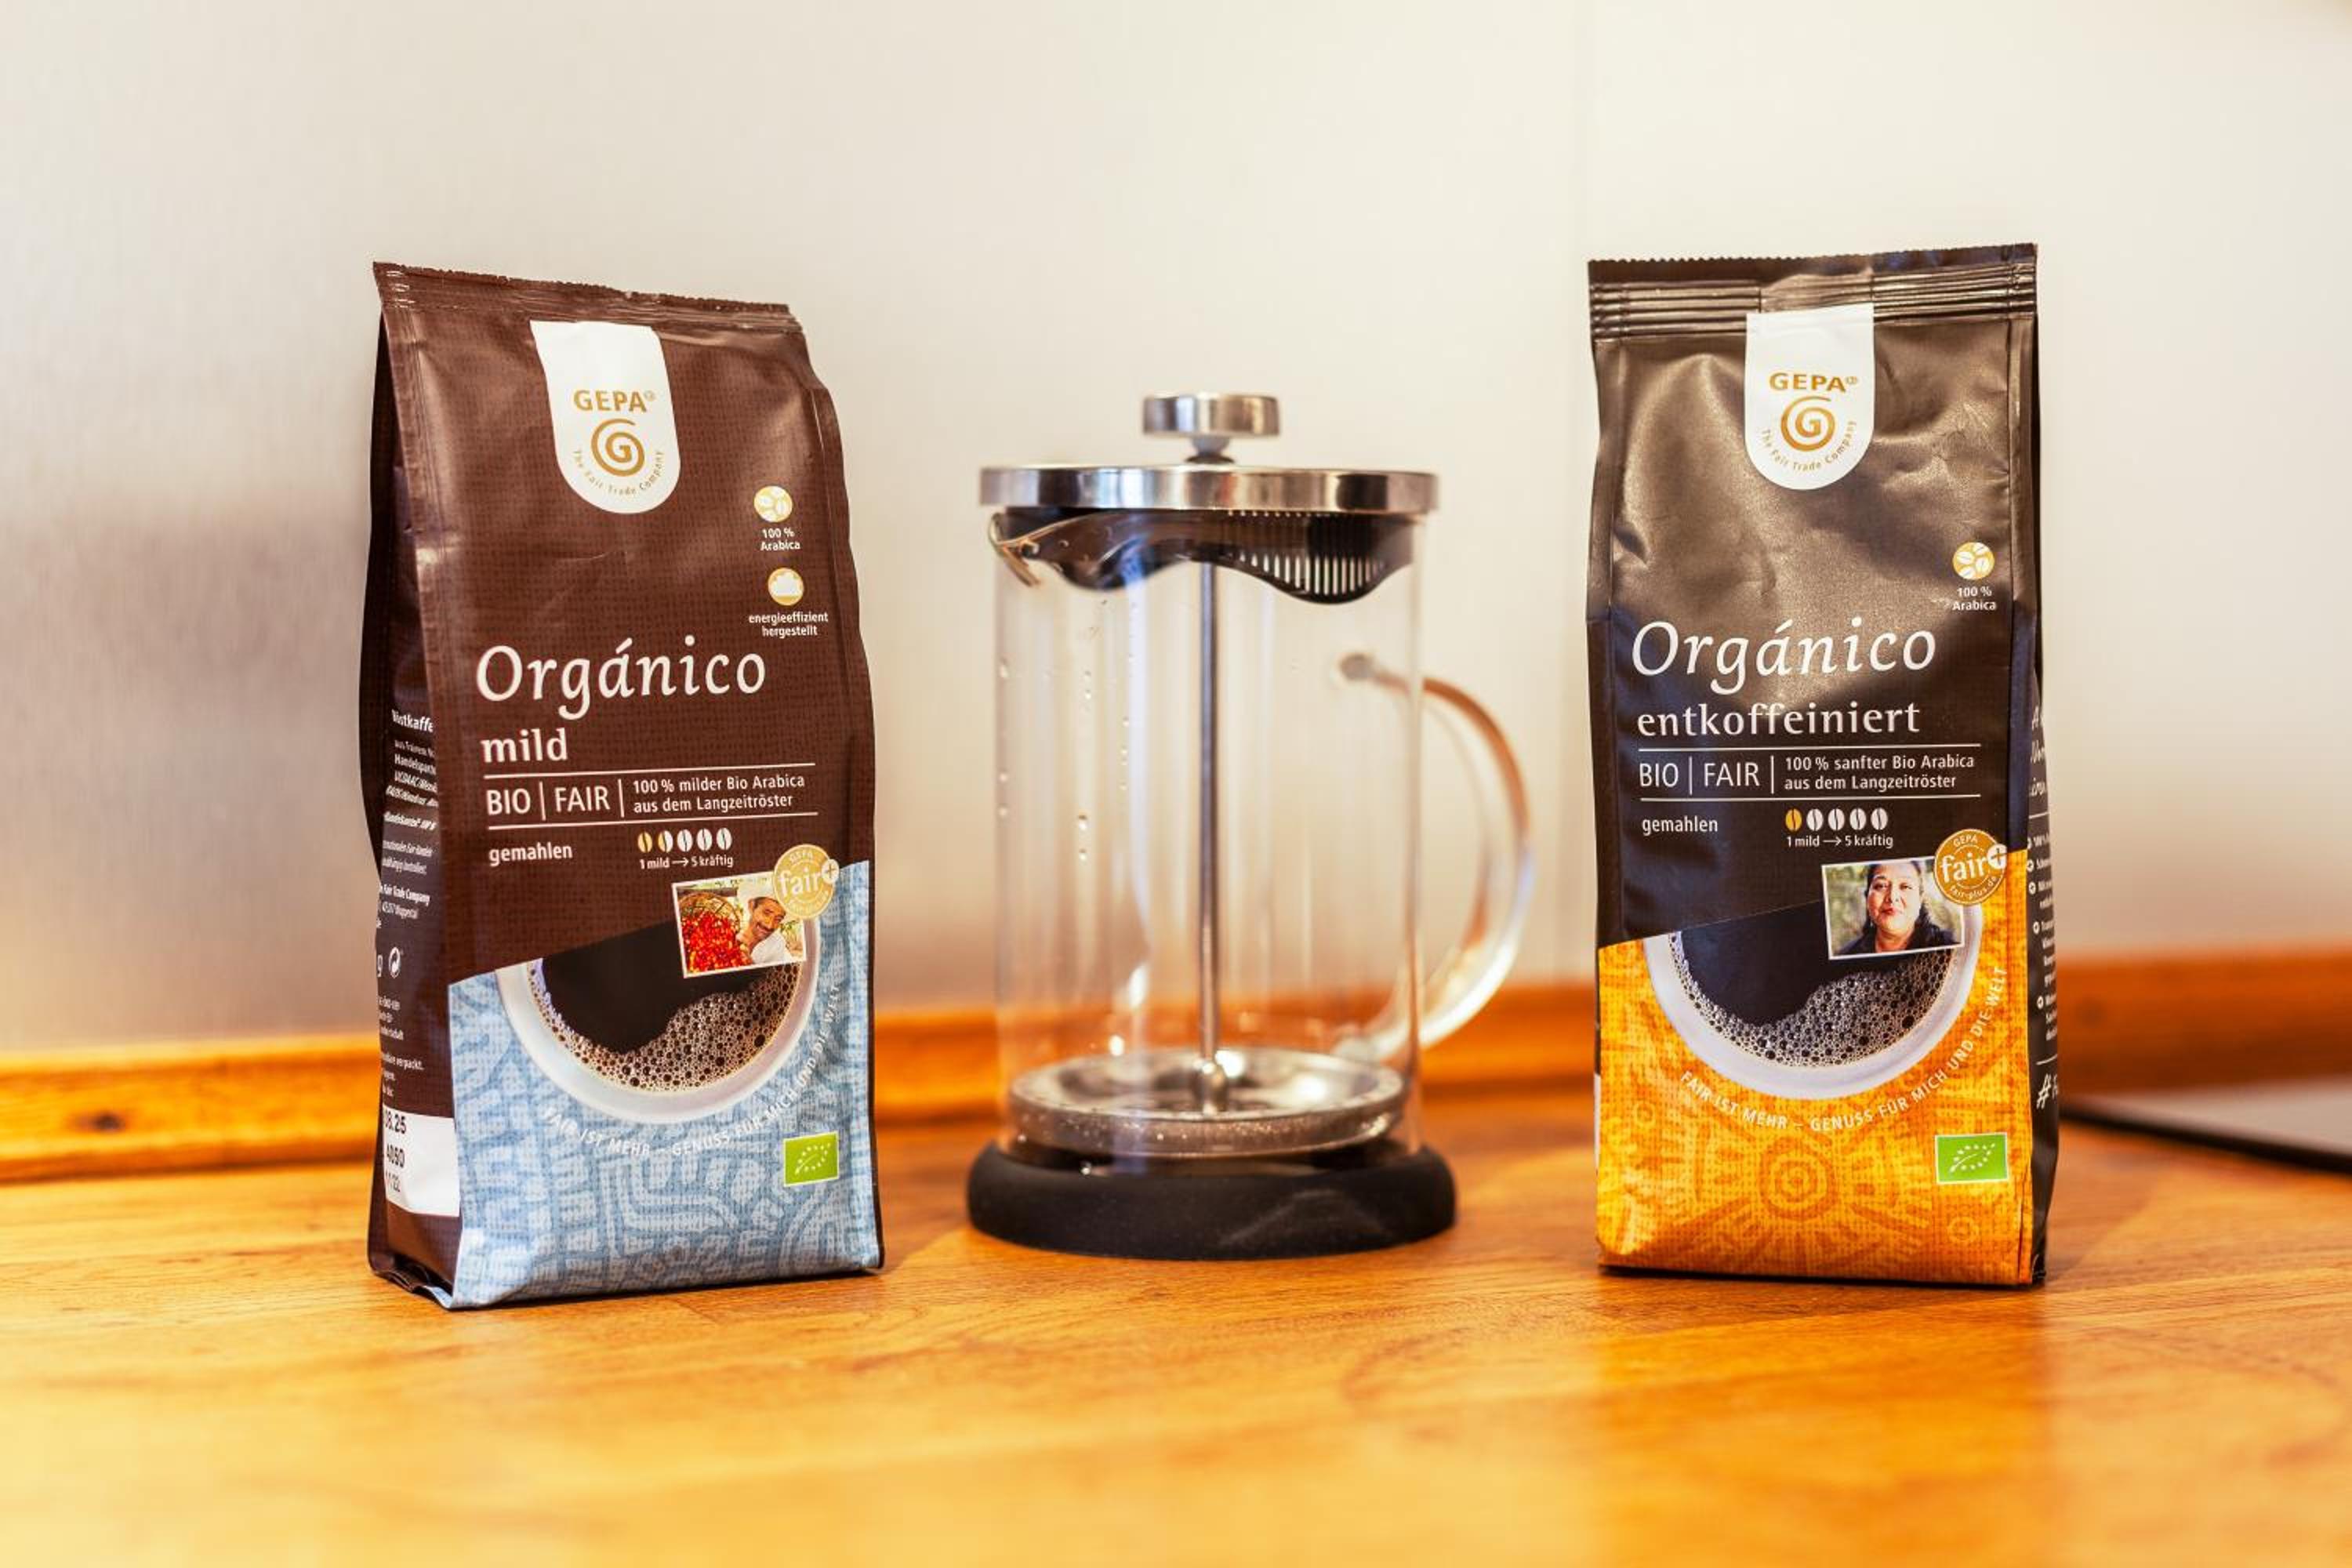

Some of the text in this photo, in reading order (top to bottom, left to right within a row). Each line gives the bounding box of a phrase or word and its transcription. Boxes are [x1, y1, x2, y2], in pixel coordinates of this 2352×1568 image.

[1772, 450, 1789, 466] Fair
[1793, 460, 1821, 471] Trade
[1824, 419, 1857, 463] Company
[608, 484, 637, 496] Trade
[639, 451, 664, 491] Company
[762, 527, 795, 539] 100 %
[760, 540, 801, 550] Arabica
[1957, 586, 1992, 597] 100 %
[1952, 600, 1997, 611] Arabica
[749, 612, 829, 626] energieeffizient
[762, 626, 818, 639] hergestellt
[1632, 616, 1936, 695] Orgánico
[477, 634, 766, 720] Orgánico
[1638, 701, 1921, 737] entkoffeiniert
[481, 727, 568, 763] mild
[1785, 754, 1975, 771] 100 % sanfter Bio Arabica
[633, 774, 804, 794] 100 % milder Bio Arabica
[1639, 762, 1760, 787] BIO FAIR
[1784, 775, 1956, 793] aus dem Langzeitröster
[486, 786, 611, 815] BIO FAIR
[633, 794, 793, 813] aus dem Langzeitröster
[1642, 815, 1719, 837] gemahlen
[1786, 834, 1893, 849] 1 mild 5 kräftig
[1953, 834, 1978, 848] GEPA
[488, 841, 573, 866] gemahlen
[647, 857, 670, 869] mild
[699, 855, 734, 868] kräftig
[1680, 1070, 1714, 1101] FAIR
[1714, 1095, 1739, 1115] IST
[1743, 1107, 1788, 1129] MEHR
[1809, 1109, 1874, 1132] GENUSS
[1878, 1097, 1909, 1118] FÜR
[1911, 1068, 1948, 1104] MICH
[1947, 1040, 1974, 1071] UND
[1969, 1010, 1992, 1038] DIE
[1985, 967, 2008, 1007] WELT
[579, 1129, 603, 1147] IST
[608, 1137, 651, 1156] MEHR
[672, 1131, 730, 1156] GENUSS
[764, 1088, 799, 1119] MICH
[796, 1058, 817, 1087] UND
[813, 1029, 831, 1054] DIE
[824, 985, 840, 1023] WELT
